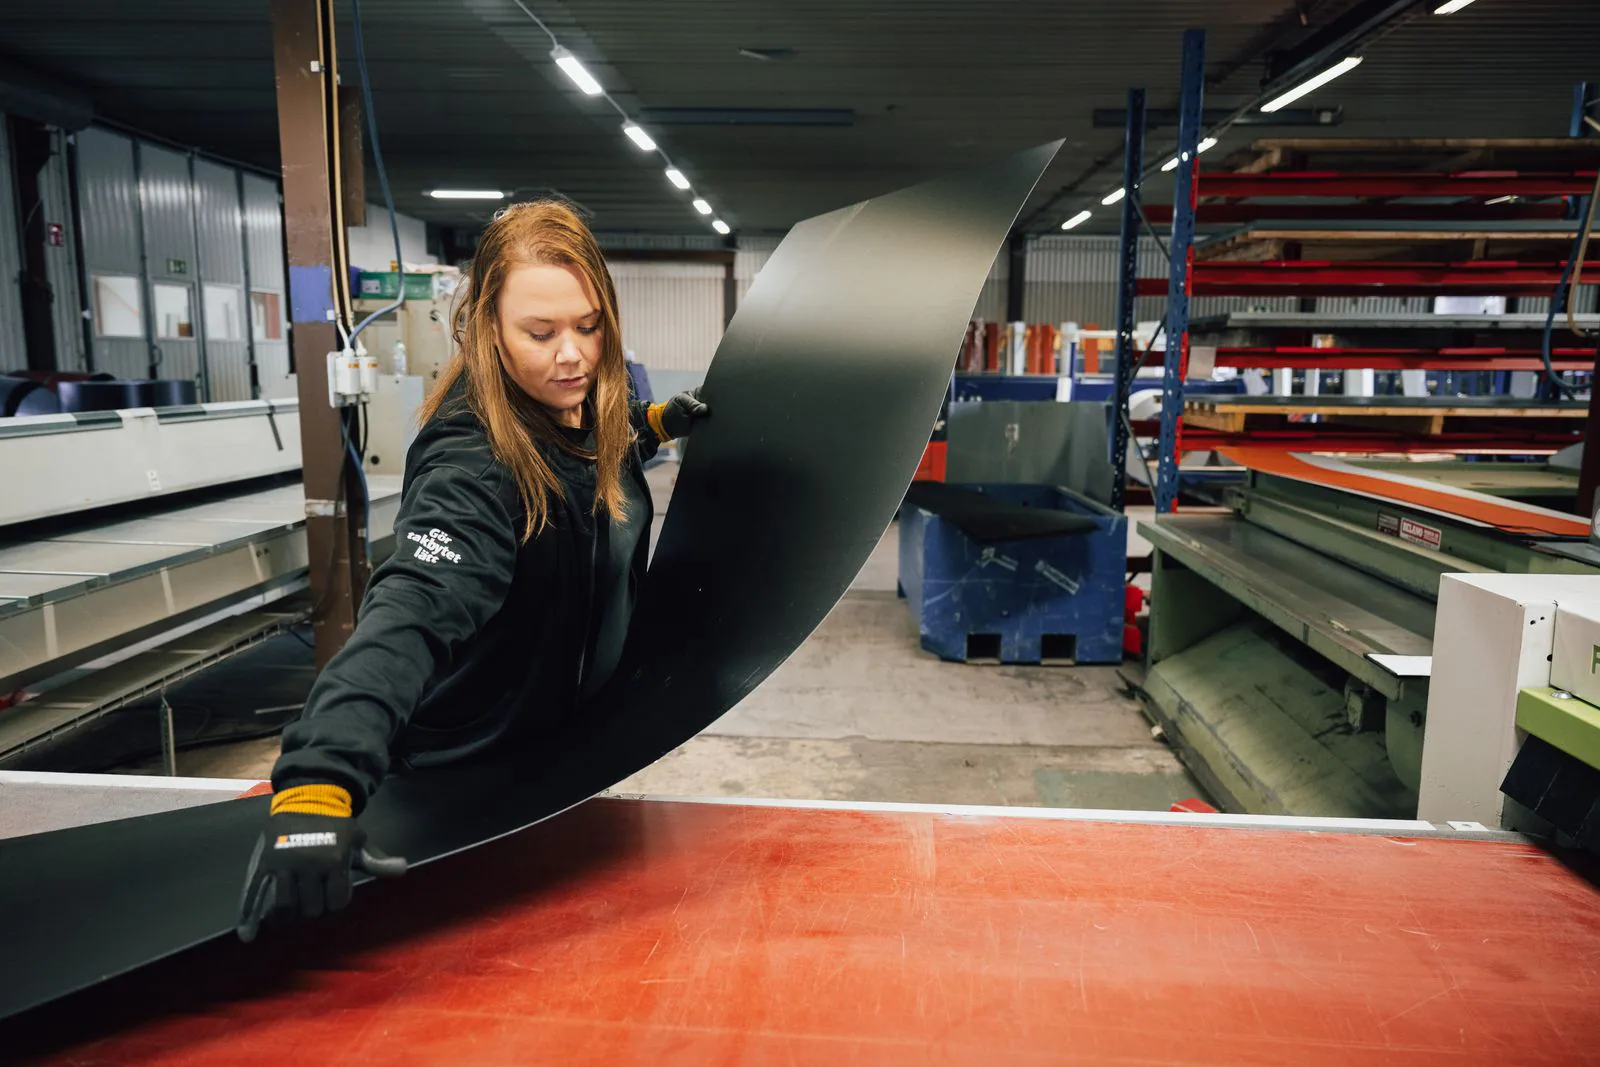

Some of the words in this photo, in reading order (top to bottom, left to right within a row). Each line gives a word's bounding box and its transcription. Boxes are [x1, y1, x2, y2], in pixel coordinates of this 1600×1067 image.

[429, 528, 453, 544] Gör
[407, 532, 462, 564] takbytet
[413, 546, 440, 564] lätt
